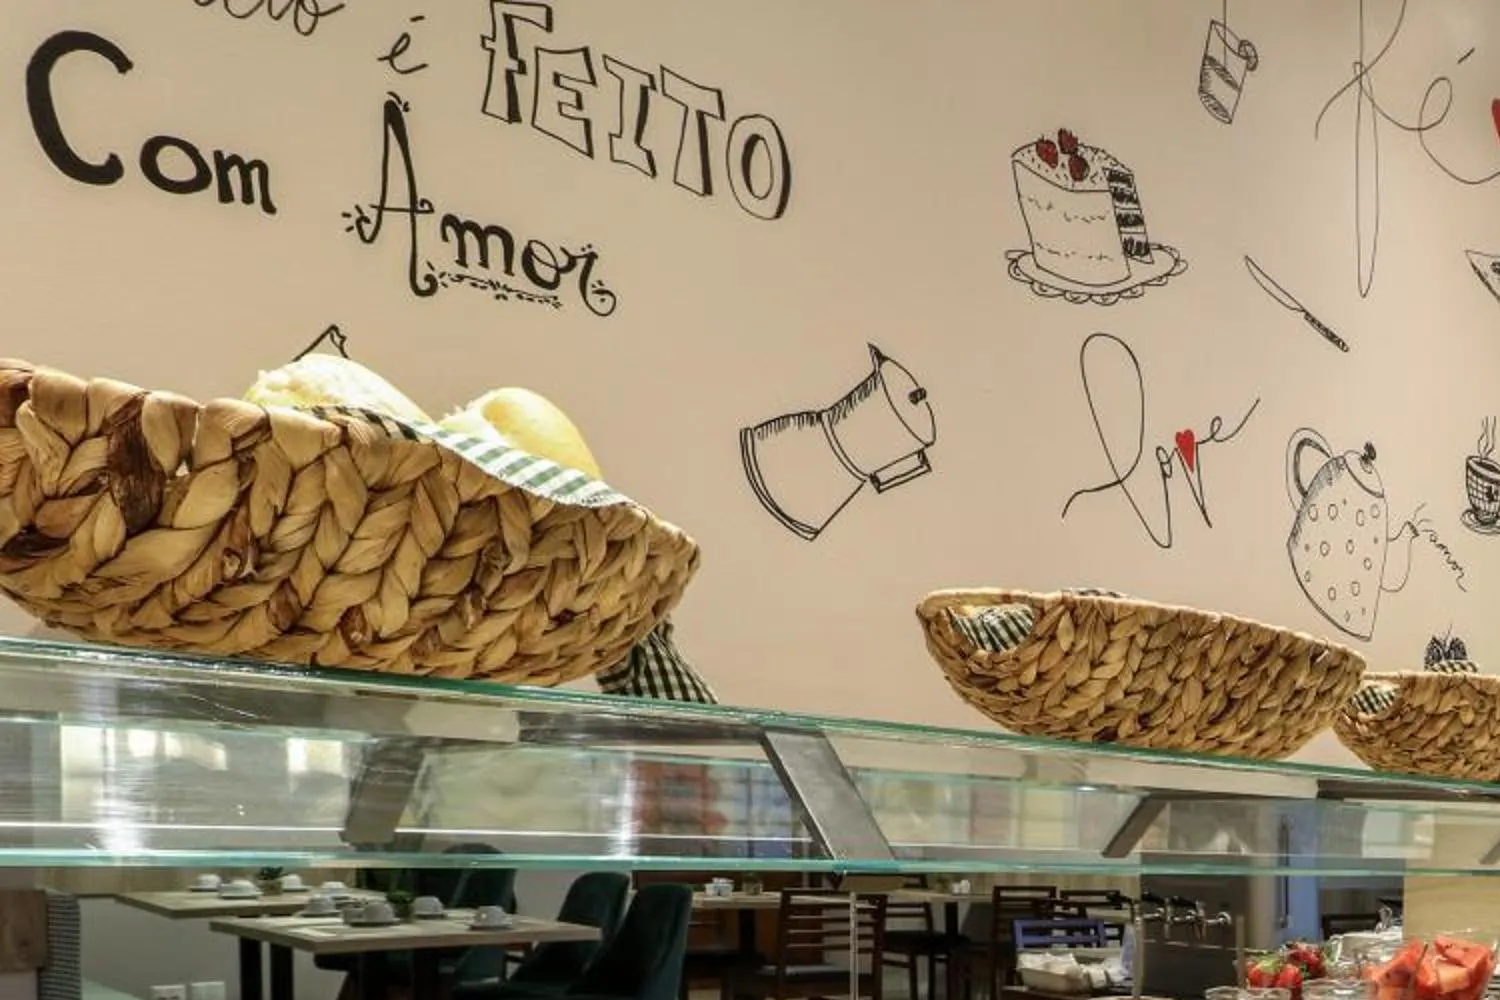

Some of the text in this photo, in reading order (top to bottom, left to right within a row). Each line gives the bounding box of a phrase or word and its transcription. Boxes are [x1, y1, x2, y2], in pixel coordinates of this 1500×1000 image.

[26, 29, 618, 317] Com Amor
[480, 0, 793, 220] FEITO
